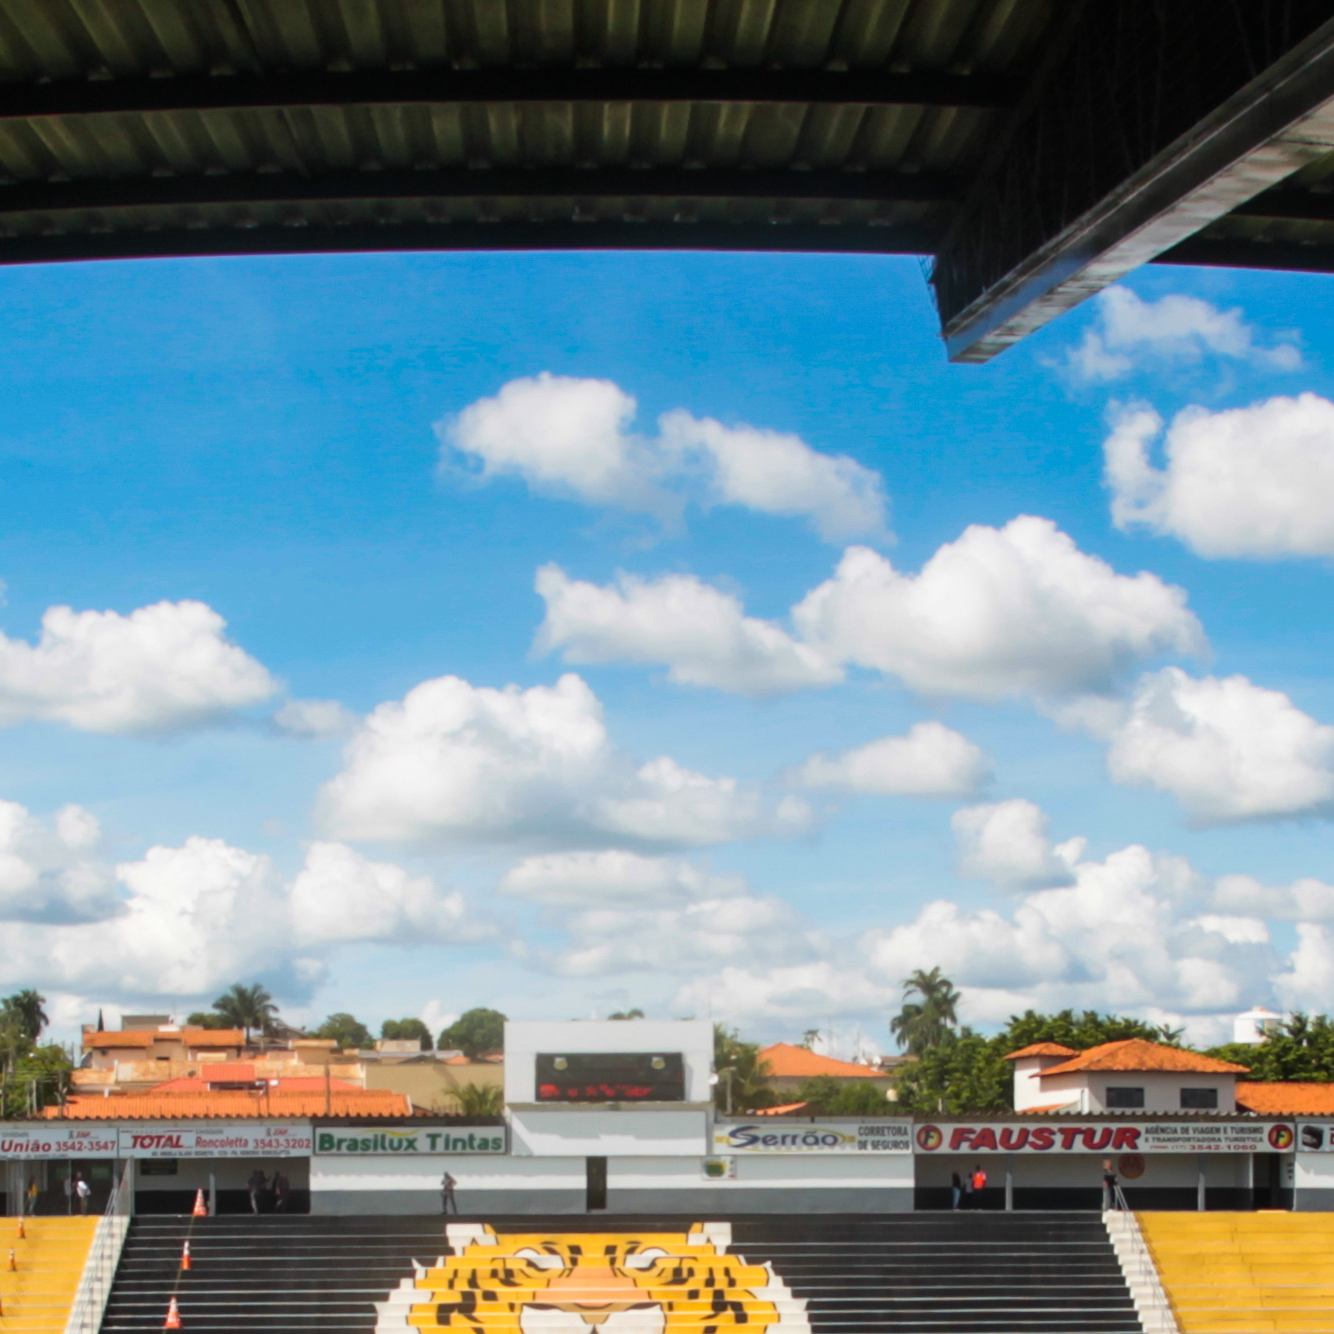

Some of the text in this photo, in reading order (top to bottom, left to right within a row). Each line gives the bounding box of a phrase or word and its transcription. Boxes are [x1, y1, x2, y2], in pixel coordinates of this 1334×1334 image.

[728, 1125, 839, 1148] Serrão
[858, 1126, 908, 1137] CORRETORA
[1145, 1124, 1178, 1135] AGÊNCIA
[1180, 1126, 1190, 1135] DE
[1192, 1126, 1220, 1134] VIAGEM
[1230, 1126, 1264, 1134] TURISMO
[0, 1137, 52, 1153] União
[131, 1134, 185, 1150] TOTAL
[318, 1132, 503, 1151] Brasilux Tintas
[858, 1139, 910, 1151] DE SEGUROS
[948, 1126, 1142, 1151] FAUSTUR
